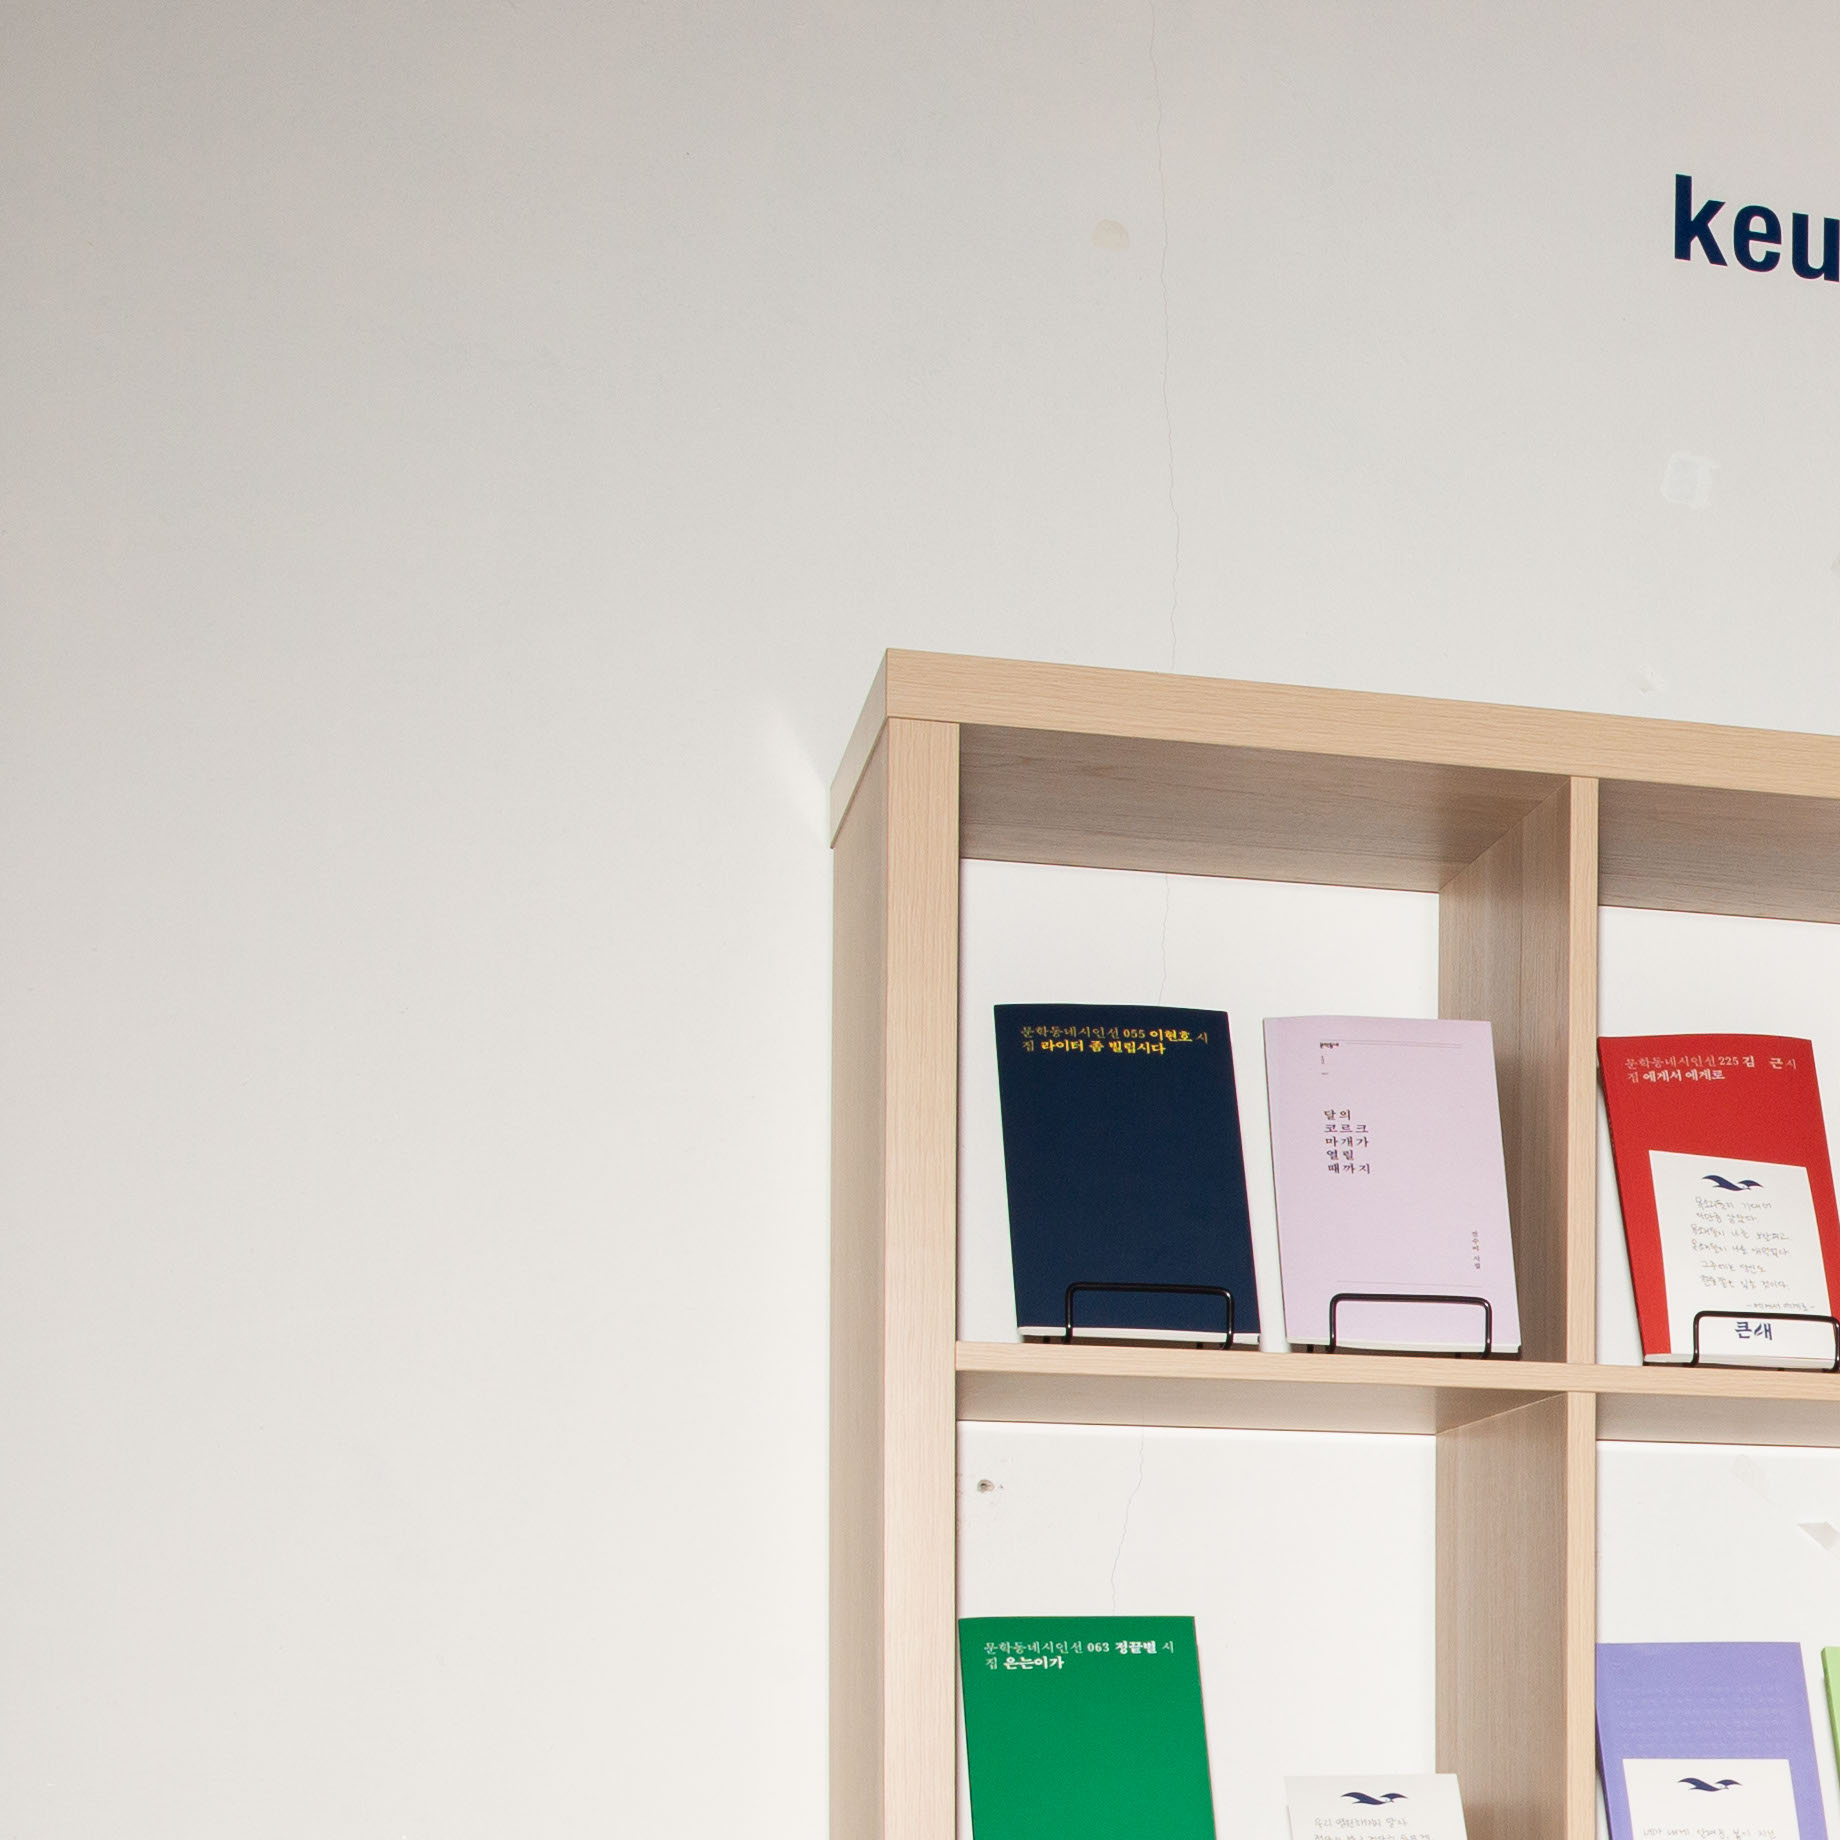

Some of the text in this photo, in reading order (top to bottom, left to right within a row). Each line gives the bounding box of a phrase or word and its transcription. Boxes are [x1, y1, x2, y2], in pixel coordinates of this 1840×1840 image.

[1123, 1028, 1192, 1042] 055 이현호
[1041, 1040, 1167, 1055] 라이터 좀 빌립시다
[1718, 1056, 1755, 1068] 225 김
[1643, 1069, 1725, 1082] 에게서 에게로
[1324, 1109, 1351, 1121] 달의
[1324, 1123, 1369, 1133] 코르크
[1325, 1136, 1369, 1148] 마개가
[1326, 1150, 1354, 1161] 열릴
[1328, 1163, 1371, 1175] 때까지
[1735, 1321, 1773, 1340] 큰새
[1087, 1641, 1158, 1654] 063 정끝별
[1003, 1656, 1064, 1670] 은는이가
